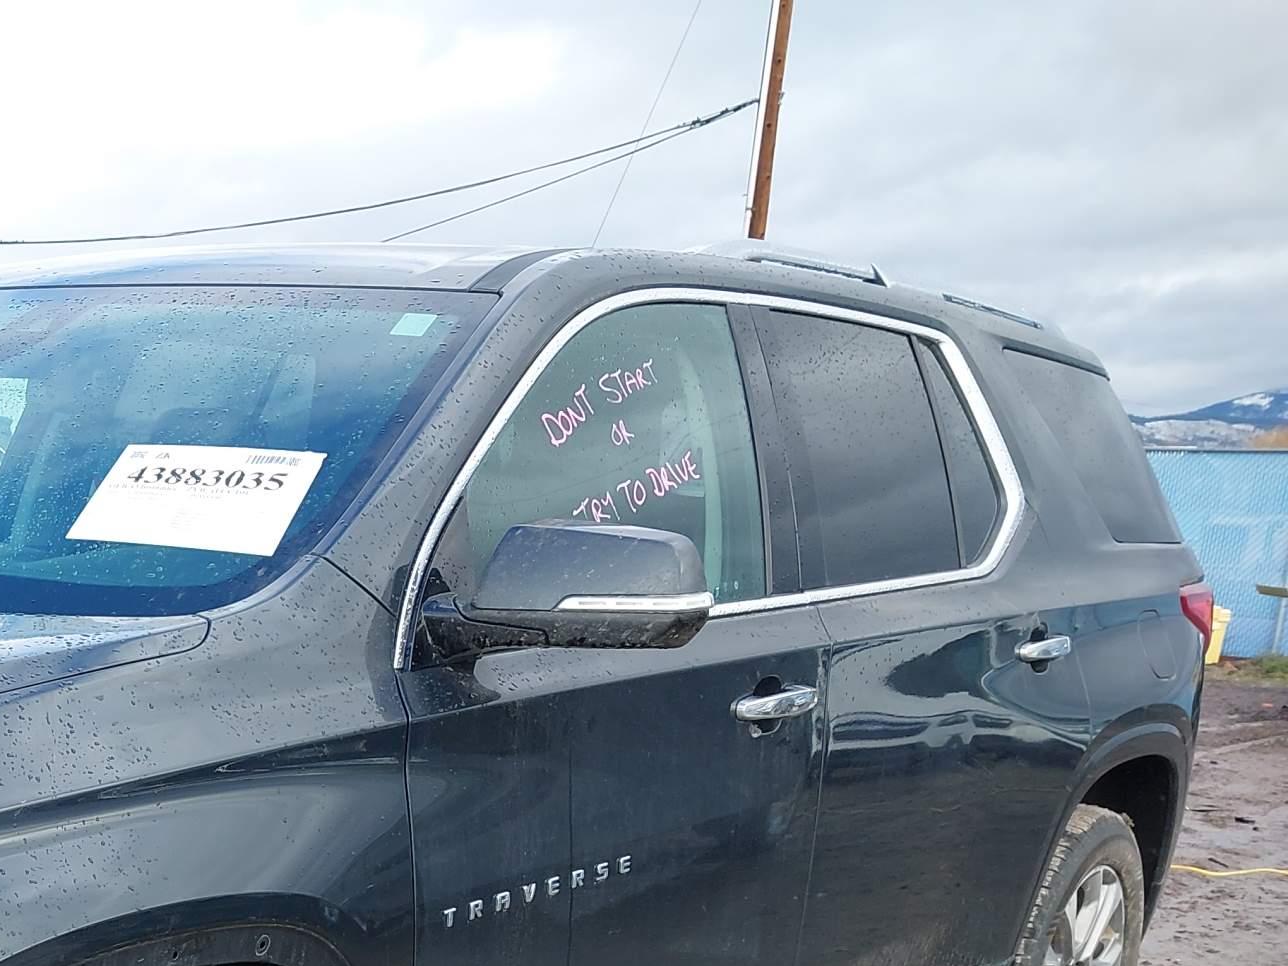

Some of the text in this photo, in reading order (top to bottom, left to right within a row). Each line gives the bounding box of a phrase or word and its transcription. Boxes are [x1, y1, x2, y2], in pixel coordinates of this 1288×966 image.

[541, 359, 658, 447] DONT START
[611, 420, 635, 445] OR
[127, 466, 289, 491] 43883035
[573, 451, 700, 522] TRY TO DRIVE
[443, 855, 632, 928] TRAVERSE
